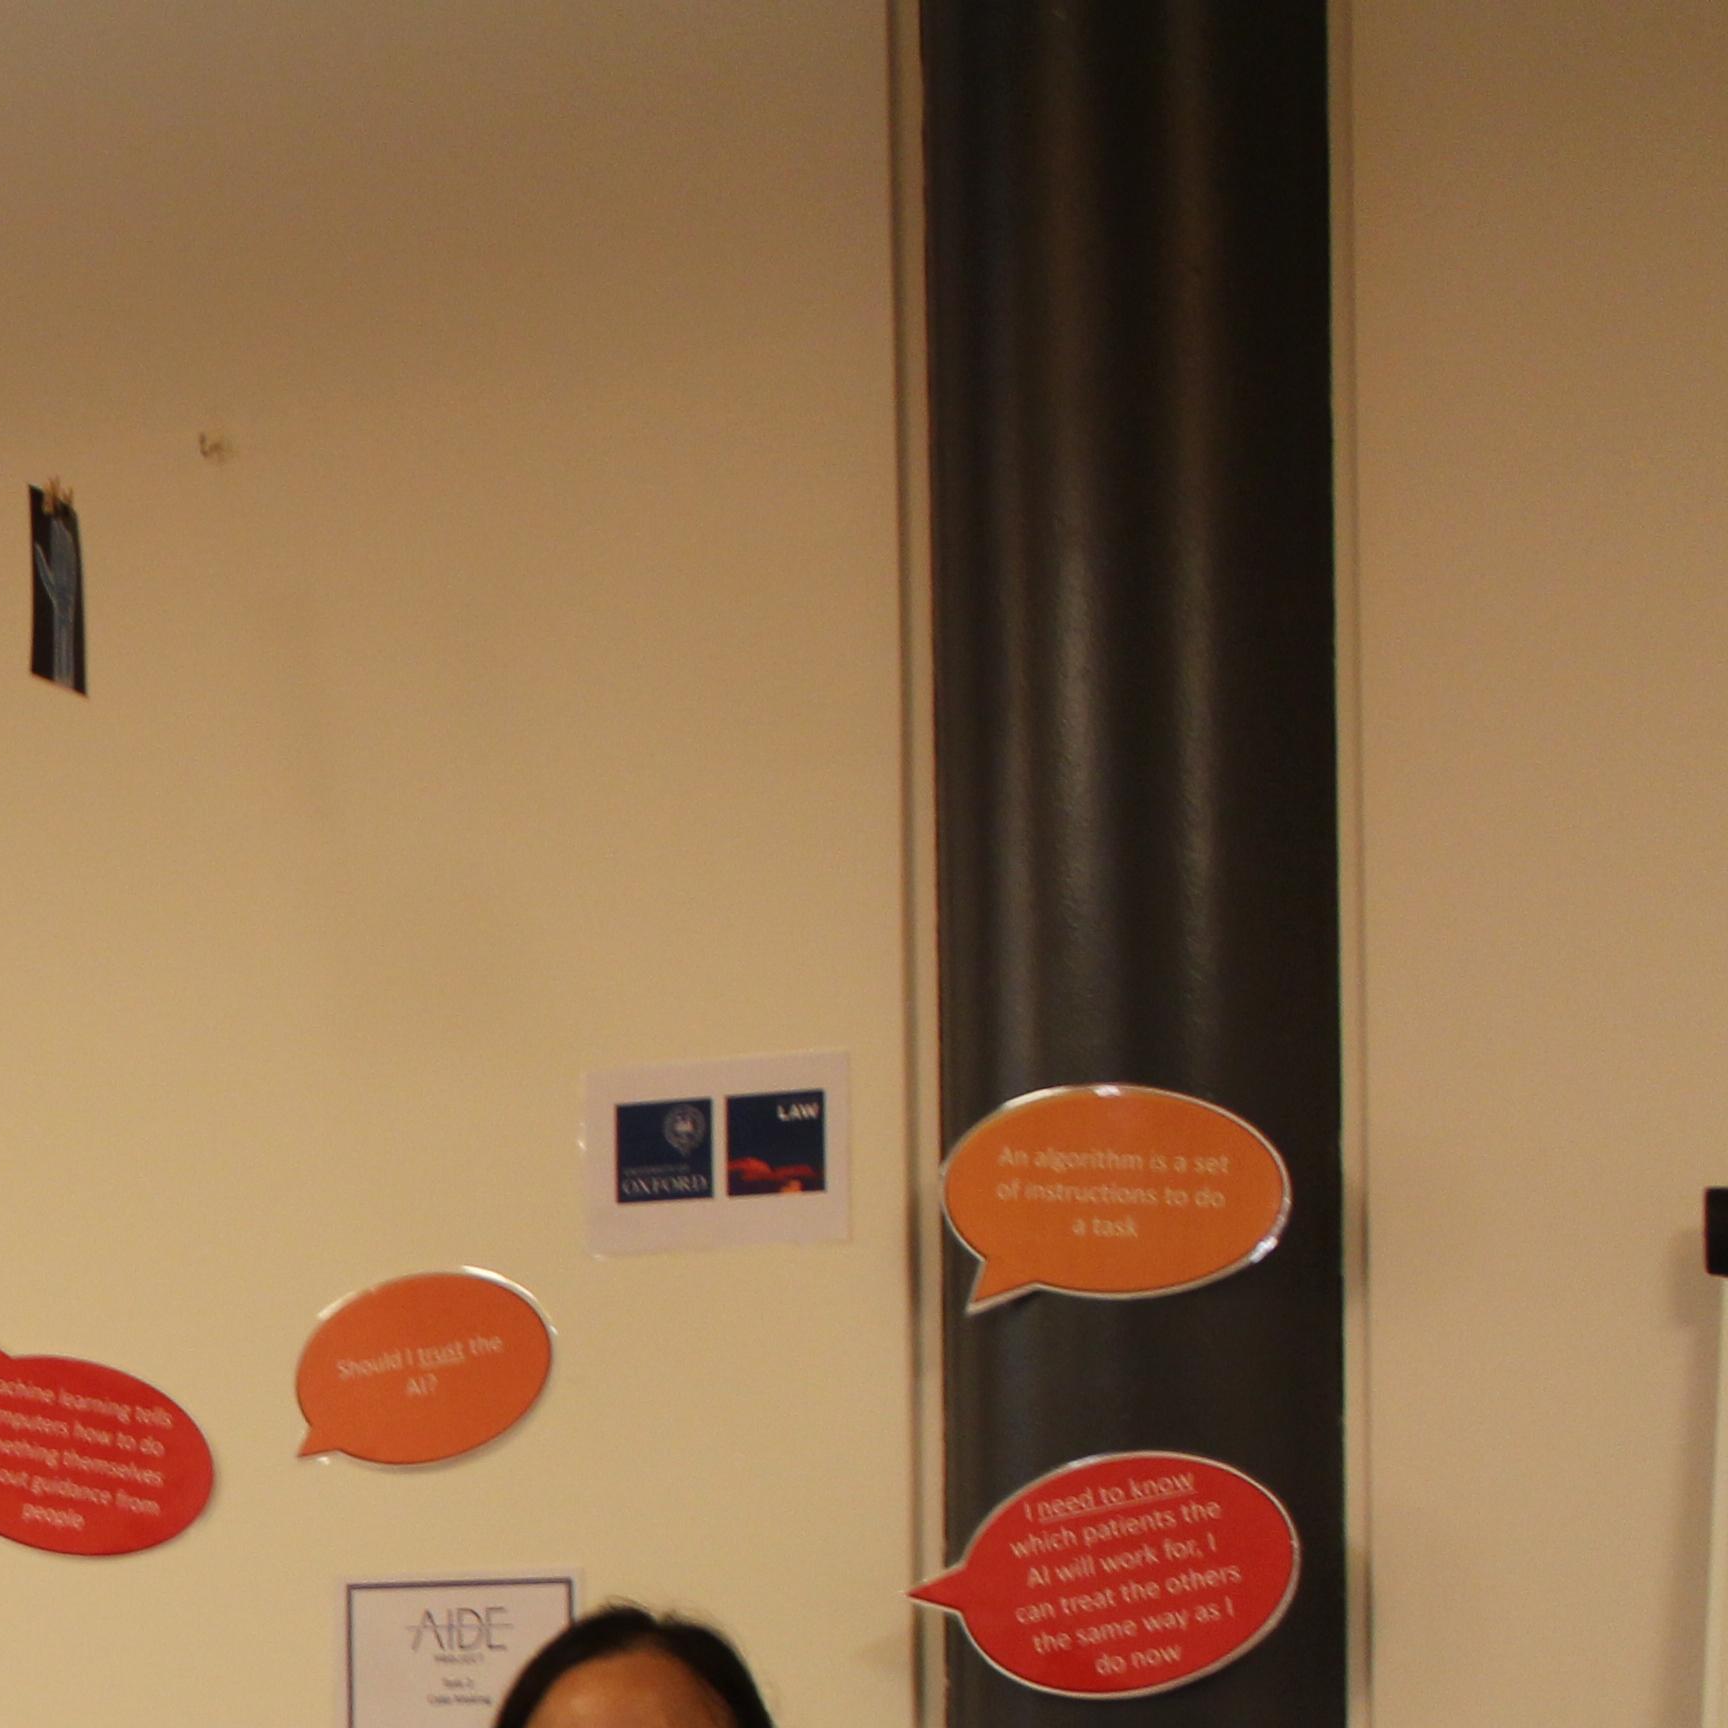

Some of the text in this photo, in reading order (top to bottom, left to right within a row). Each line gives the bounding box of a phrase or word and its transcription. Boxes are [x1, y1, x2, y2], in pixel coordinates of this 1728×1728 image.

[776, 1101, 821, 1122] LAW
[998, 1146, 1229, 1175] An algorithm is a set
[622, 1174, 709, 1196] OXFORD
[996, 1178, 1225, 1209] of instructions to do
[1072, 1215, 1137, 1239] a task
[336, 1336, 503, 1380] Should I trust the
[406, 1373, 439, 1397] AI?
[58, 1387, 132, 1425] learning
[134, 1405, 173, 1430] tells
[72, 1418, 114, 1446] how
[115, 1431, 137, 1452] to
[139, 1436, 166, 1458] do
[62, 1449, 165, 1488] themselves
[30, 1475, 114, 1506] guidance
[114, 1489, 161, 1517] from
[1023, 1473, 1196, 1523] I need to know
[22, 1502, 86, 1531] people
[1009, 1501, 1223, 1559] which patients the
[1027, 1532, 1217, 1589] AI will work for, I
[1015, 1565, 1242, 1624] can treat the others
[404, 1606, 515, 1653] AIDE
[1032, 1595, 1235, 1655] the same way as I
[1094, 1644, 1182, 1676] do now
